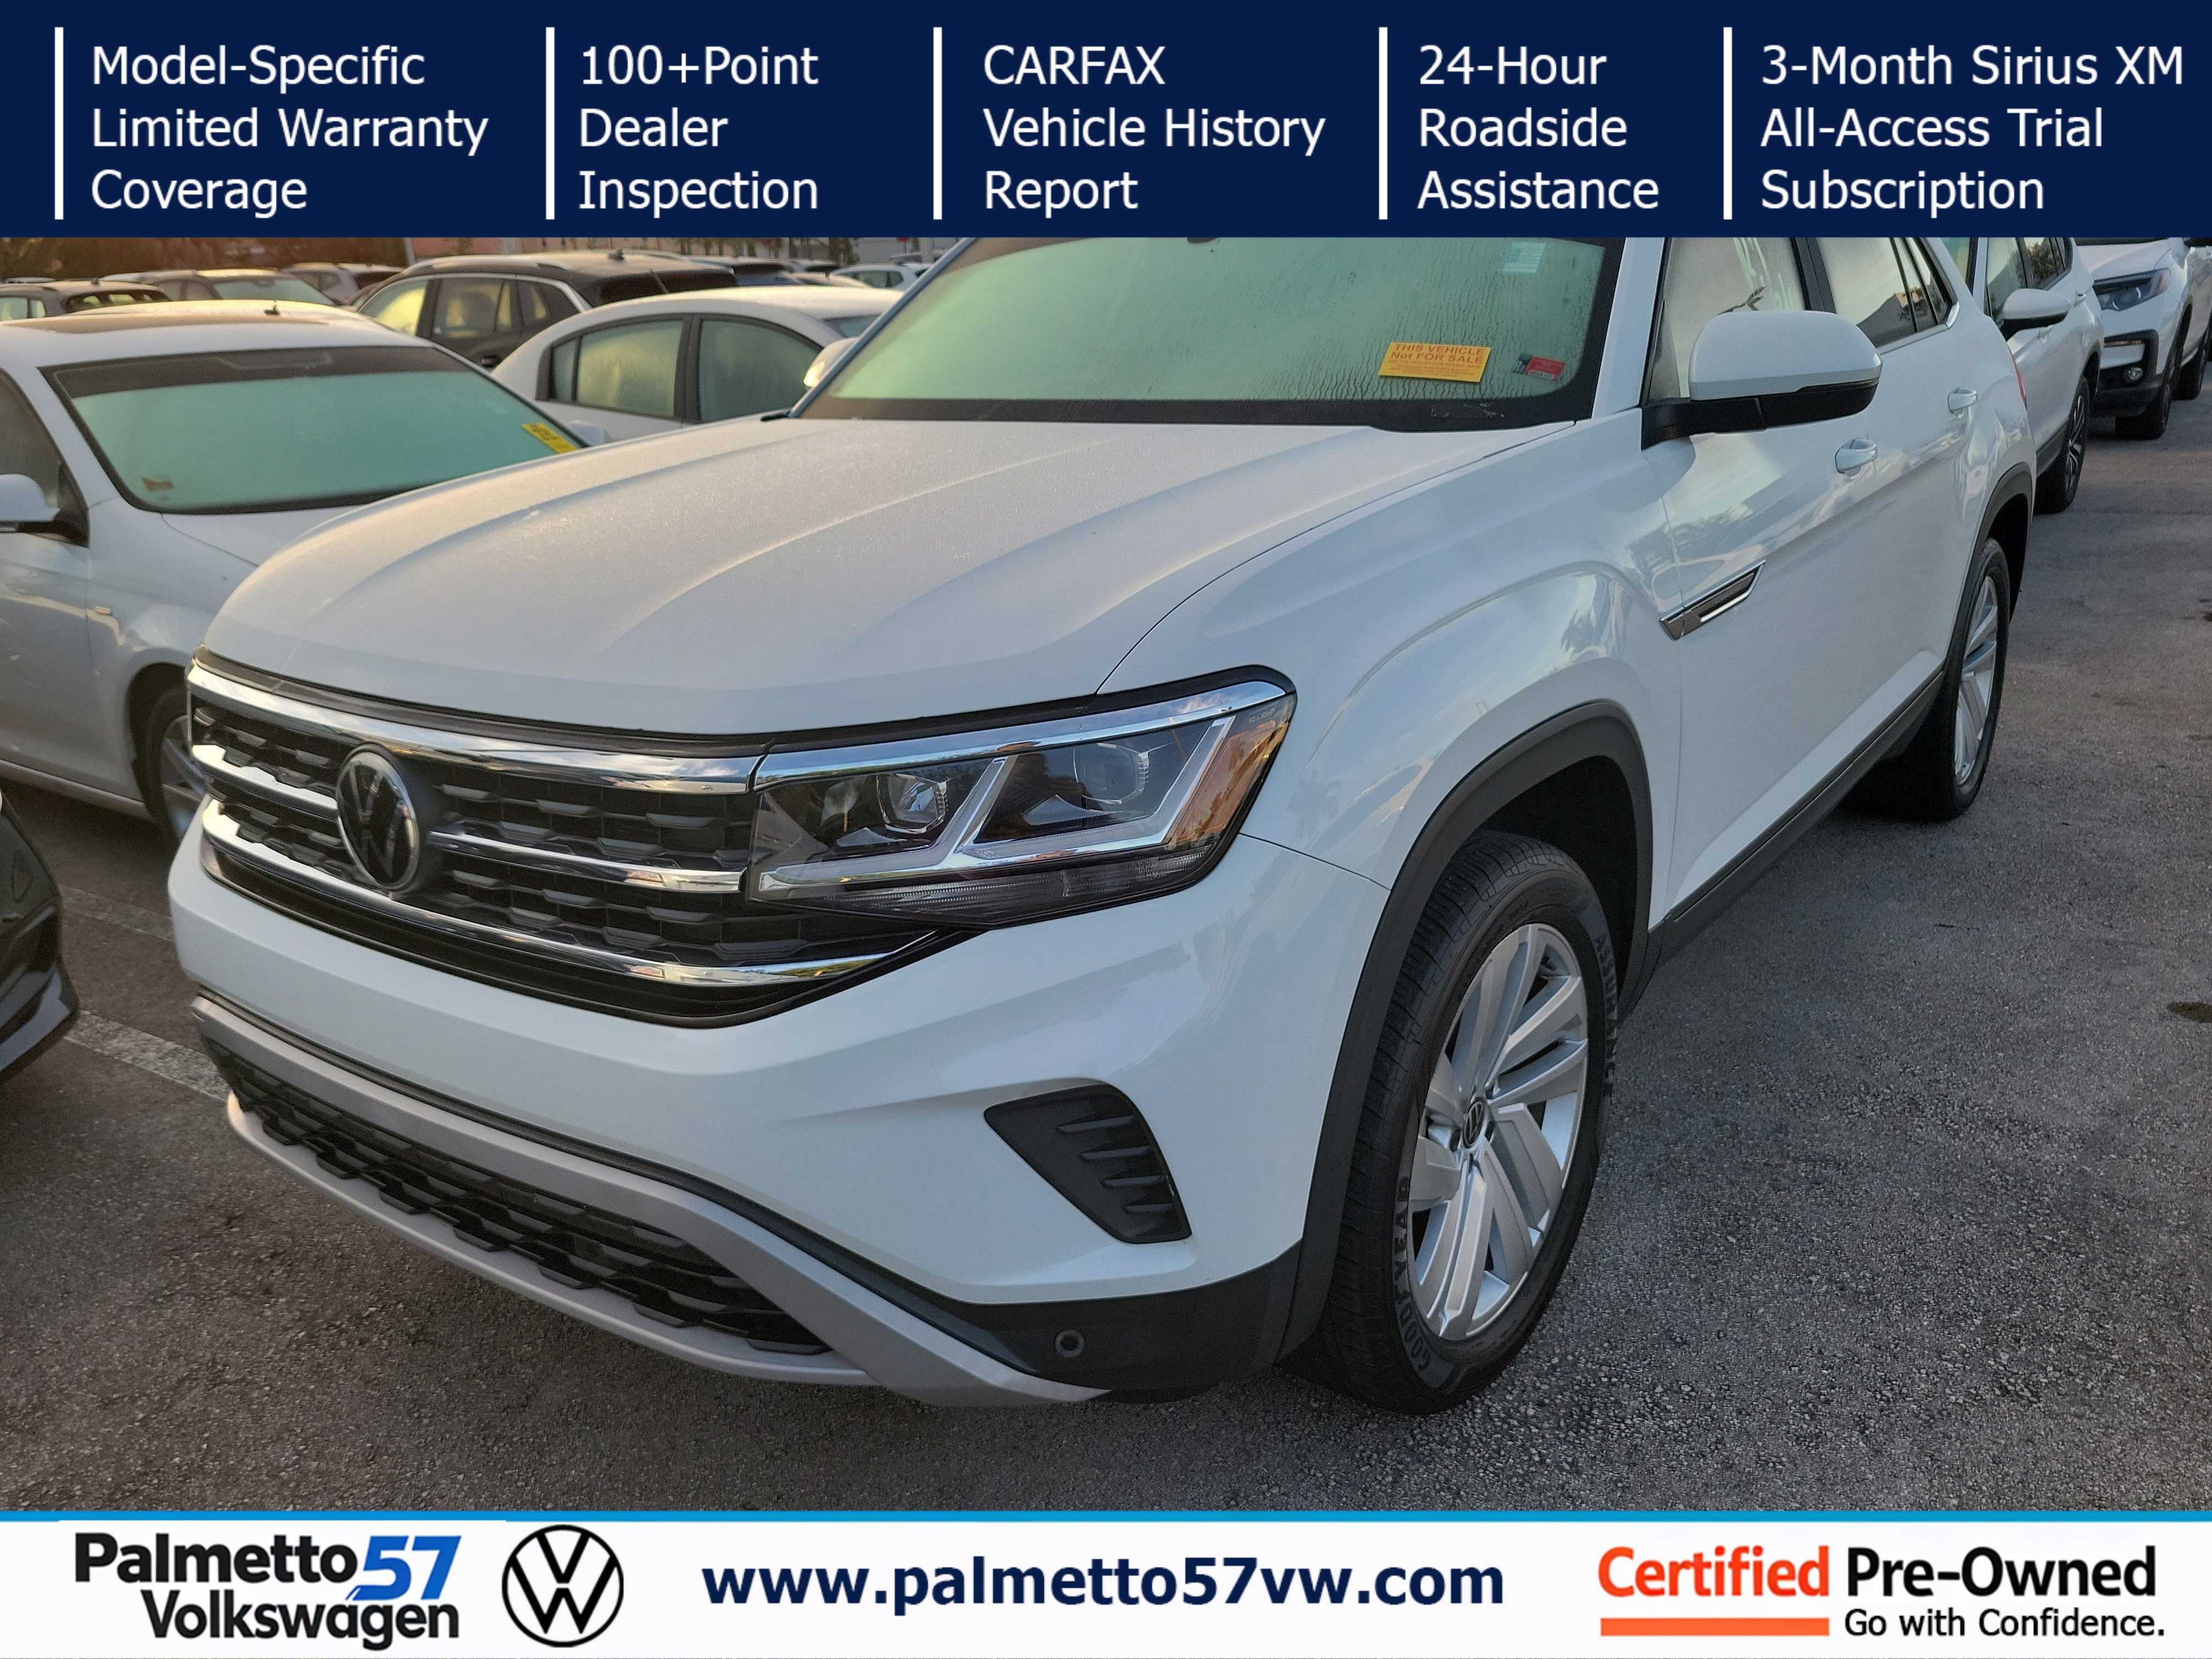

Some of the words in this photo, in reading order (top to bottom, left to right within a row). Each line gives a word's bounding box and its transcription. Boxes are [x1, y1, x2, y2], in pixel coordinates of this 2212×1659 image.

[1395, 344, 1424, 352] THIS
[1429, 345, 1485, 356] VEHICLE
[1448, 354, 1483, 364] SALE
